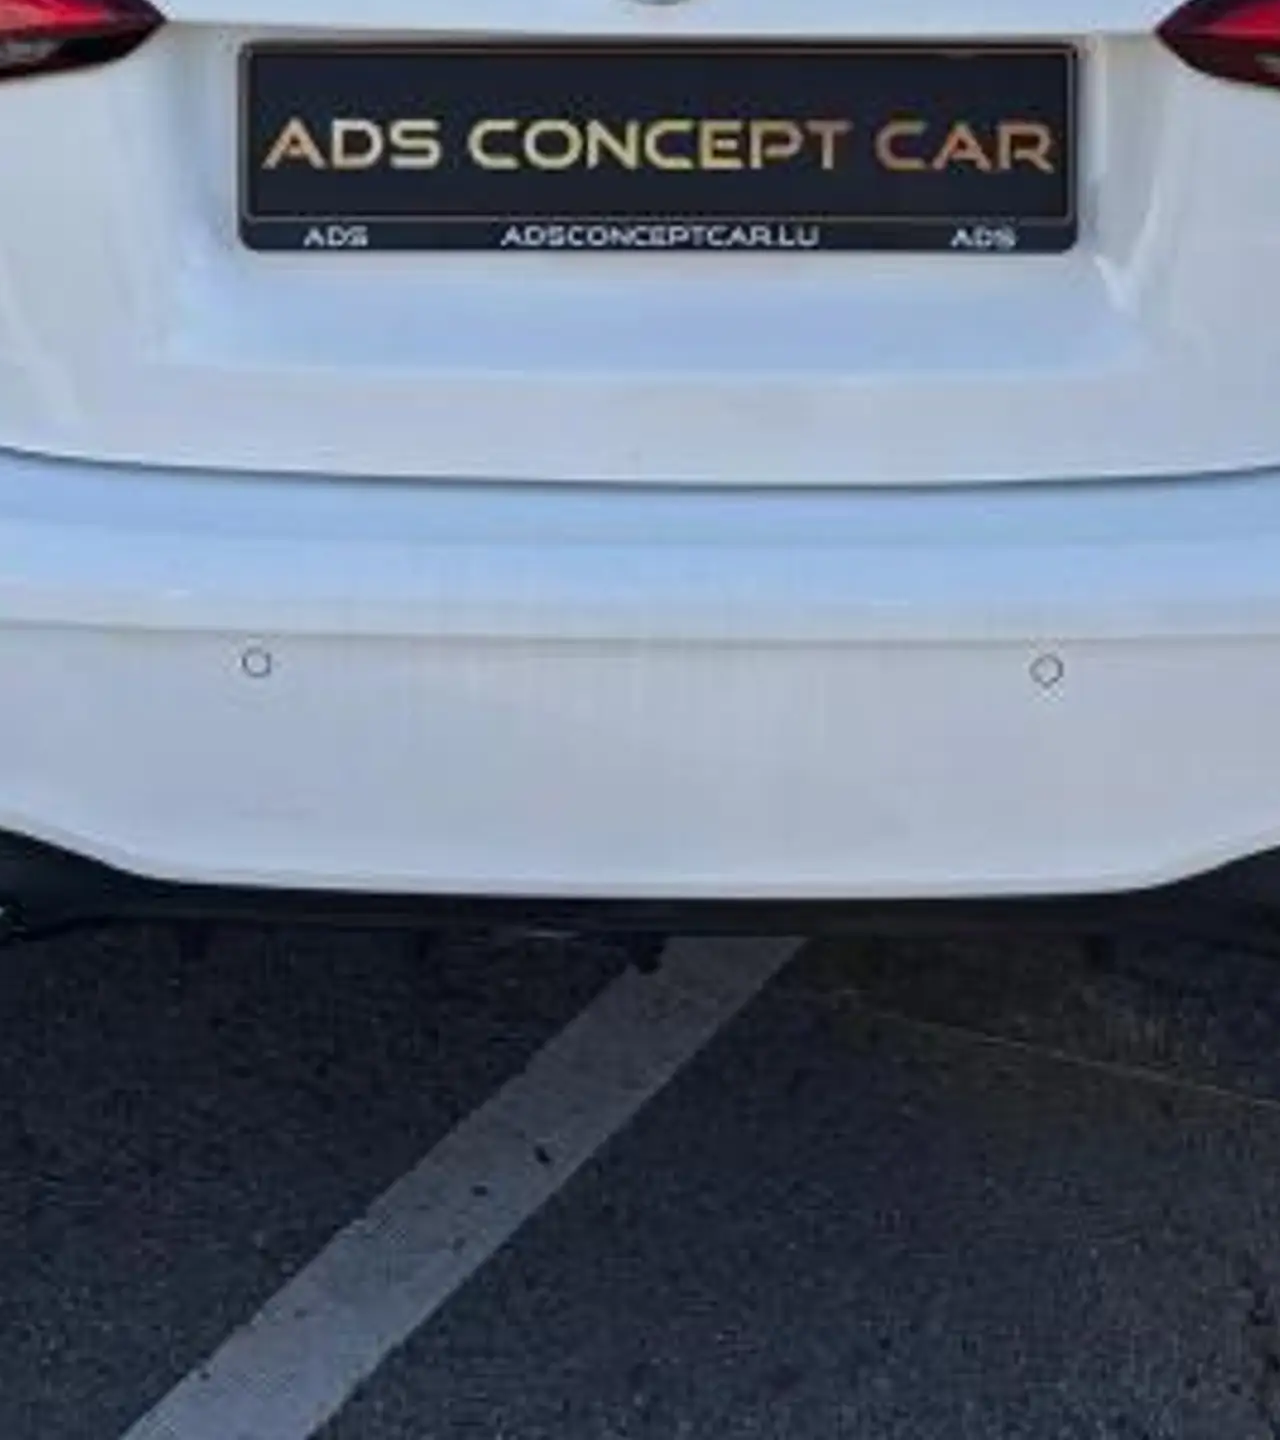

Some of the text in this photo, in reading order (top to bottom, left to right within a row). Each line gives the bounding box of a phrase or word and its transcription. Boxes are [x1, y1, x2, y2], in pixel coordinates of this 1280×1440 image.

[262, 116, 1054, 174] ADS CONCEPT CAR
[303, 224, 370, 248] ADS
[500, 224, 820, 249] ADSCONCEPTCAR.LU
[950, 225, 1017, 249] ADS
